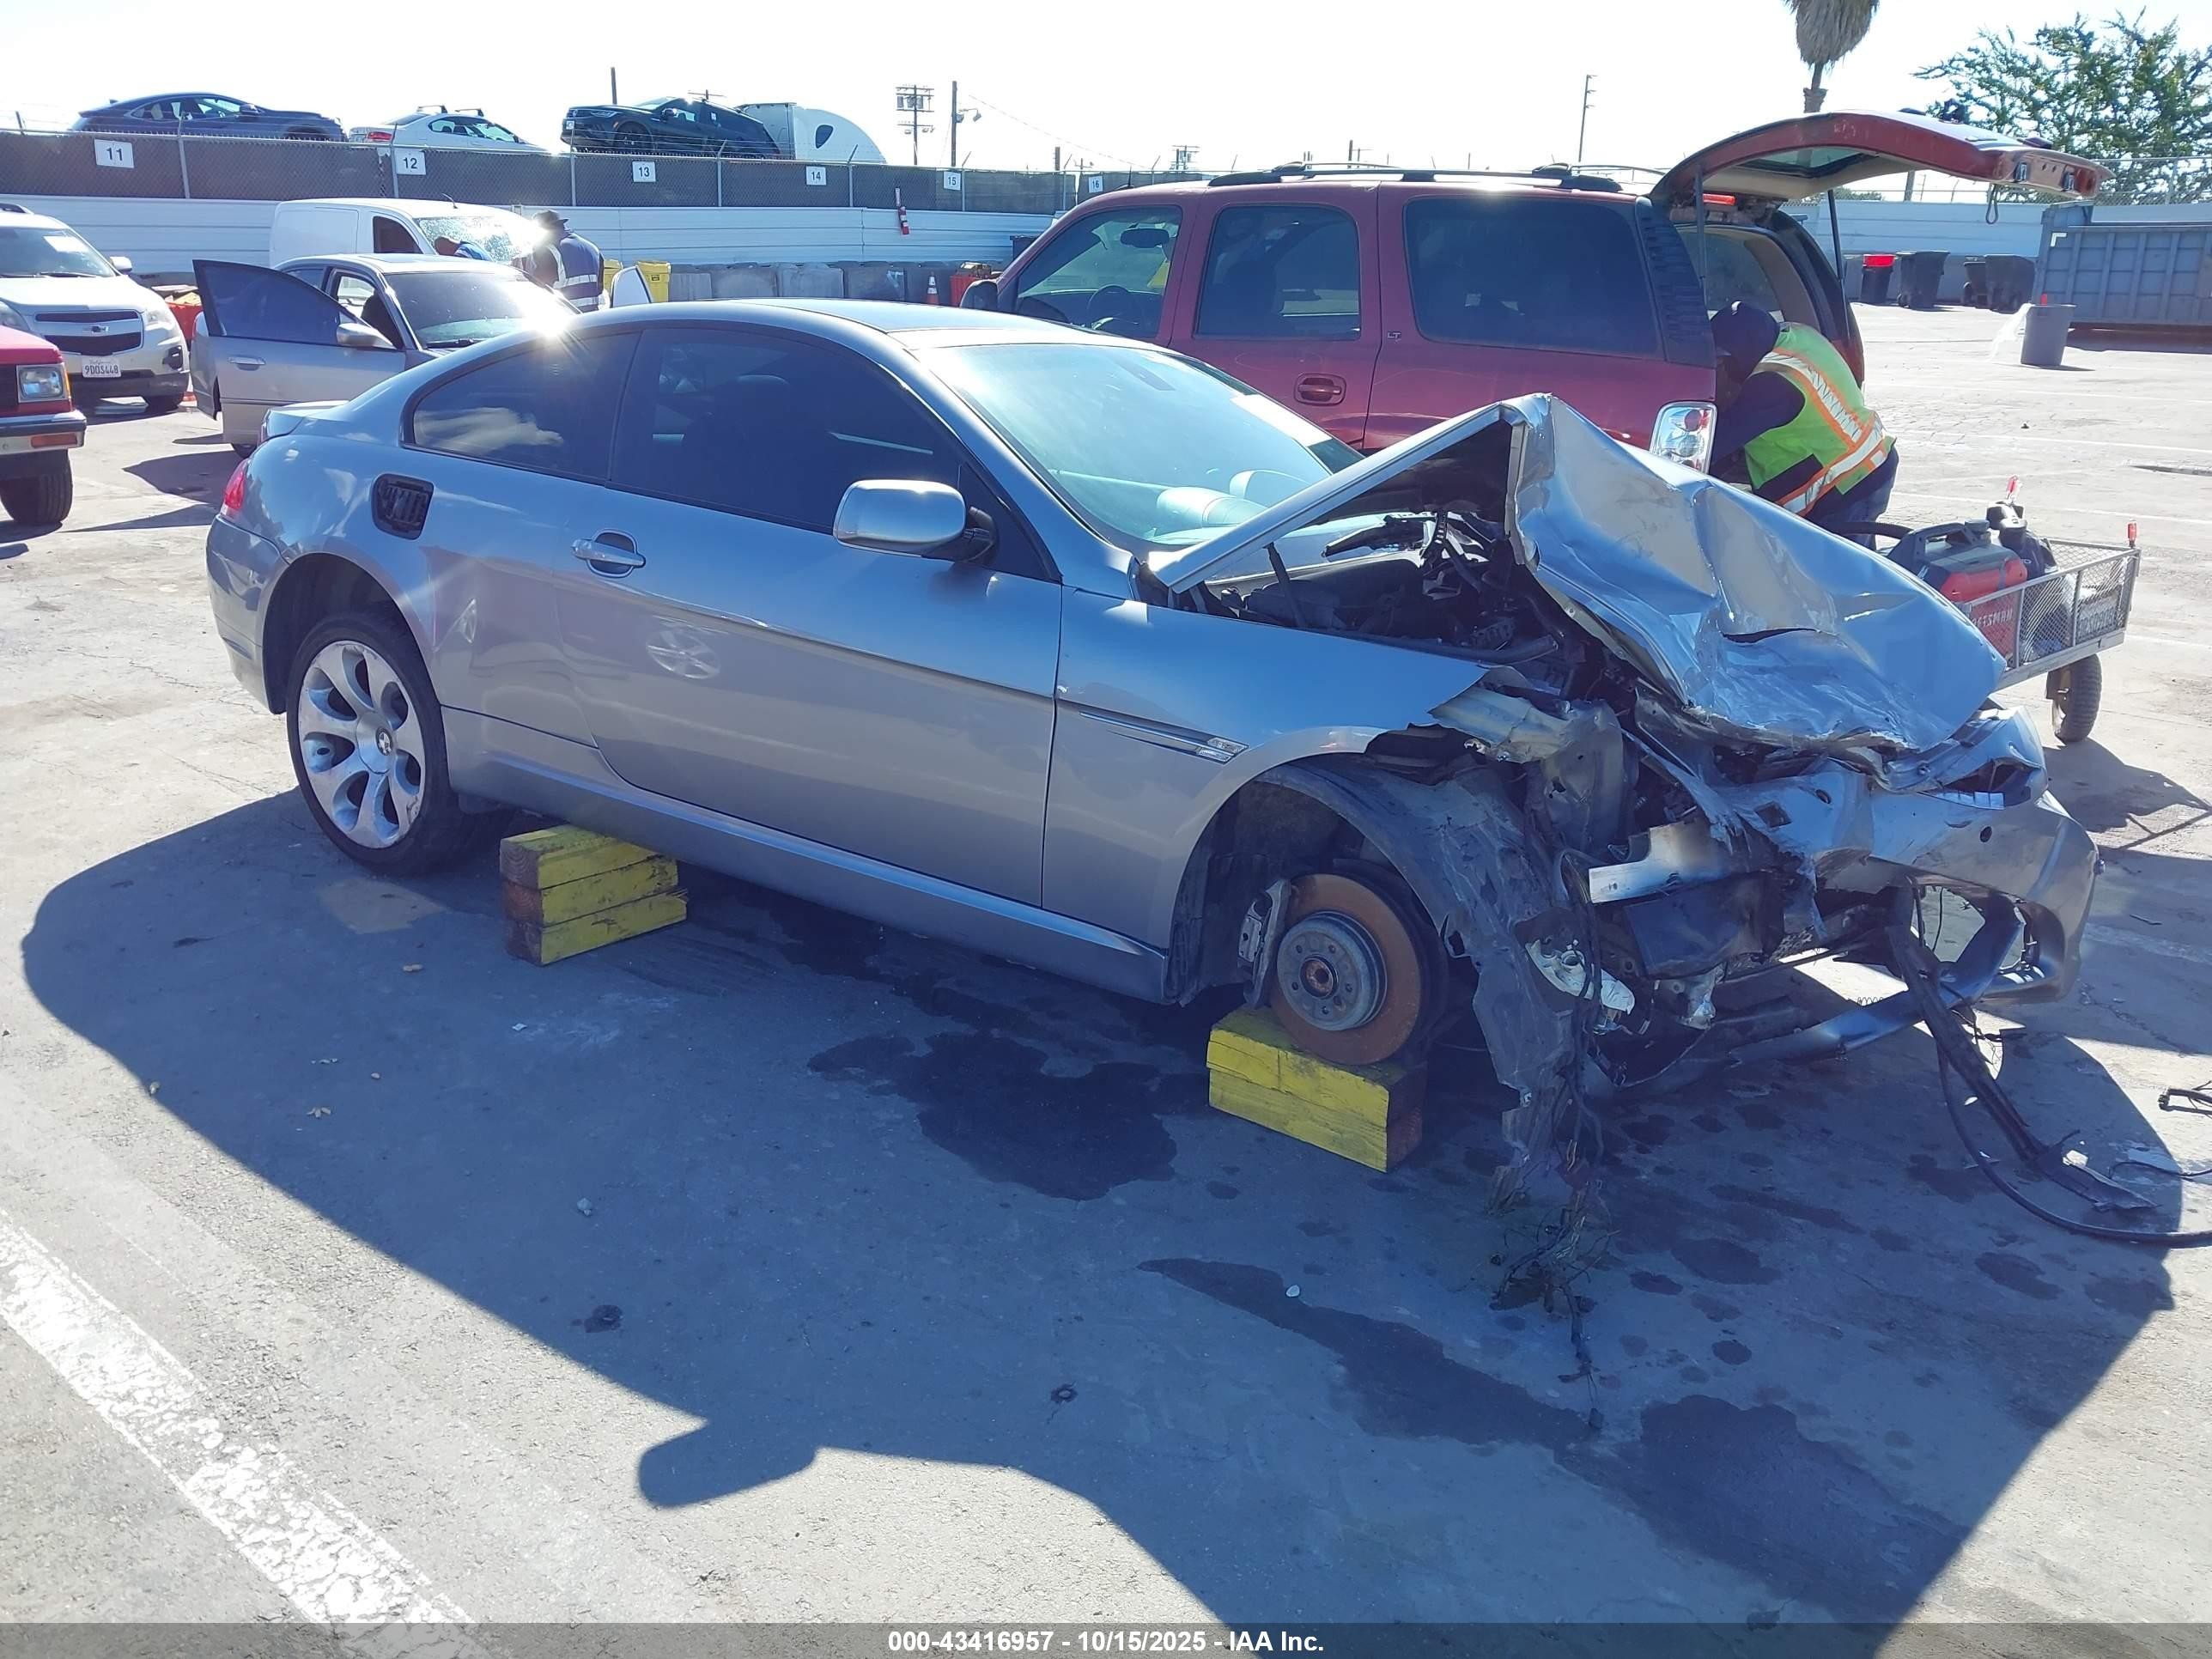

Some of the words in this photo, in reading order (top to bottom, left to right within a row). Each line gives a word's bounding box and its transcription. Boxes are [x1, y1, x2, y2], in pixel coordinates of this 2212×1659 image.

[106, 147, 123, 161] 11
[403, 156, 418, 170] 12
[638, 166, 650, 178] 13
[810, 171, 822, 181] 14
[947, 176, 957, 186] 15
[1091, 179, 1101, 189] 16
